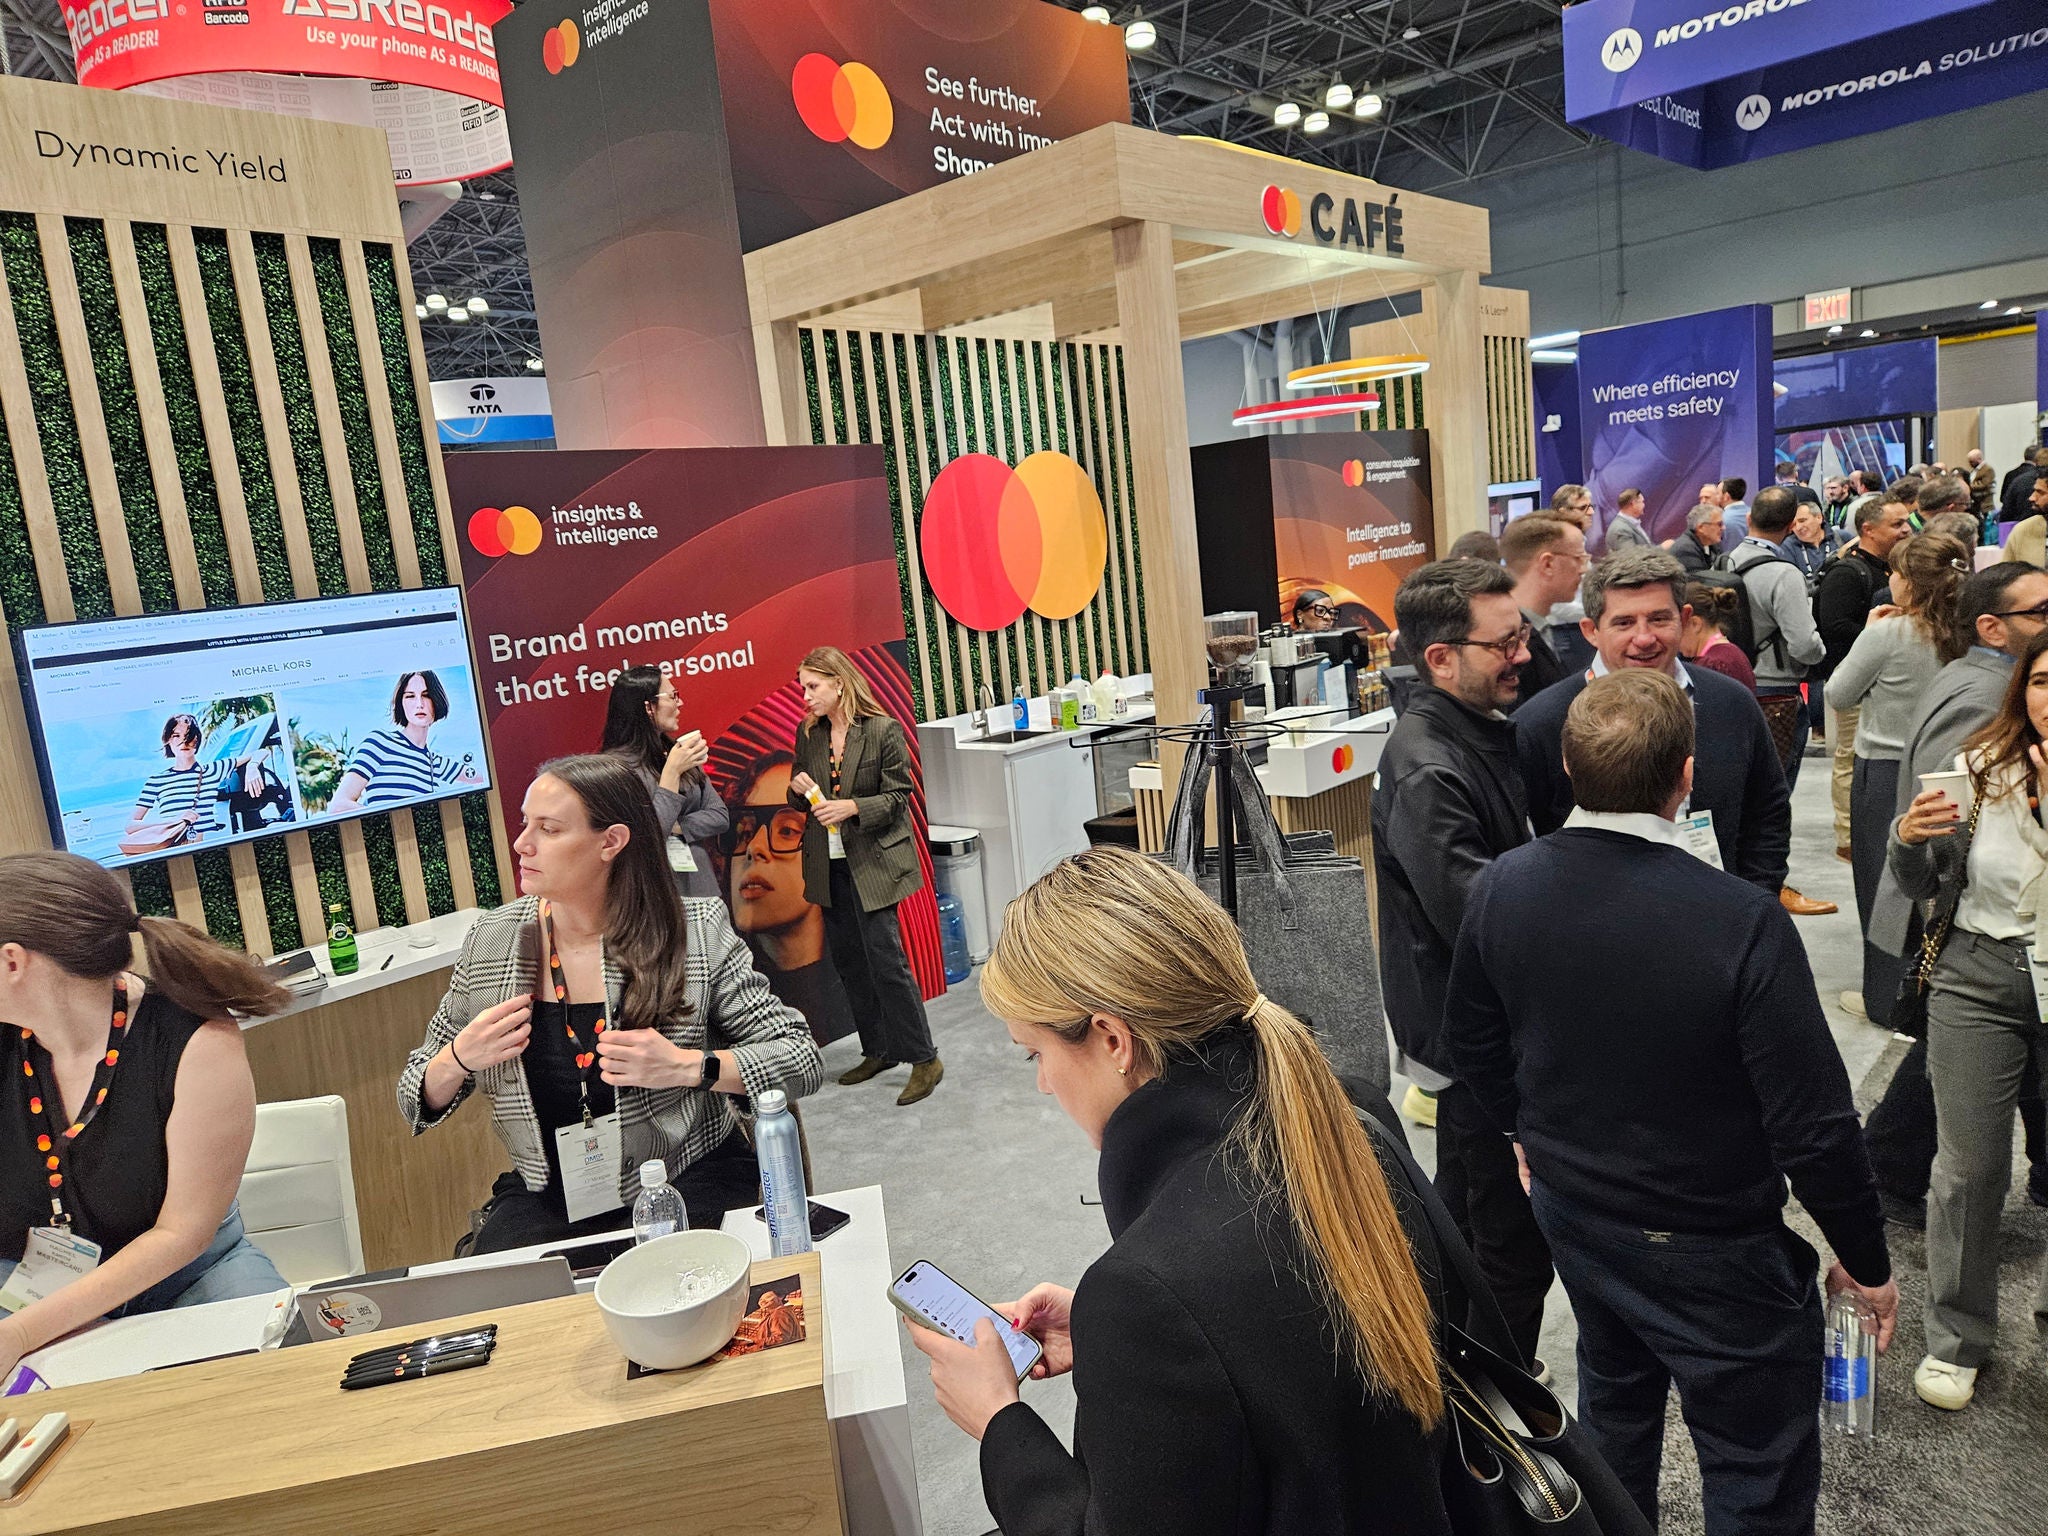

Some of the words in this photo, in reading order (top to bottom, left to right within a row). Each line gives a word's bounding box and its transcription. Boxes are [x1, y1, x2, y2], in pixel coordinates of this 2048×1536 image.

[204, 12, 249, 25] Barcode
[585, 0, 649, 48] intelligence
[94, 45, 104, 65] AS
[105, 46, 111, 60] a
[112, 29, 159, 56] READER!
[306, 26, 336, 44] Use
[340, 32, 378, 49] your
[382, 37, 427, 60] phone
[429, 47, 446, 65] AS
[449, 54, 457, 67] a
[371, 82, 399, 91] Barcode
[924, 66, 964, 100] See
[968, 77, 1042, 119] further.
[1780, 59, 1933, 112] MOTOROLA
[463, 117, 482, 131] RFID
[929, 107, 967, 138] Act
[969, 119, 1014, 149] with
[34, 129, 200, 174] Dynamic
[205, 149, 287, 183] Yield
[1310, 193, 1405, 253] CAFÉ
[1808, 293, 1850, 323] EXIT
[1592, 382, 1649, 404] Where
[1652, 368, 1740, 395] efficiency
[468, 404, 502, 415] TATA
[1609, 404, 1664, 425] meets
[1667, 395, 1724, 418] safety
[1366, 460, 1392, 470] consumer
[1392, 456, 1420, 469] acquisition
[1366, 471, 1371, 482] &
[1372, 469, 1407, 483] engagement
[551, 504, 626, 526] insights
[628, 501, 644, 520] &
[554, 524, 659, 547] intelligence
[1346, 523, 1399, 543] Intelligence
[1400, 520, 1412, 535] to
[1348, 550, 1378, 570] power
[1378, 540, 1426, 561] innovation
[489, 623, 588, 663] Brand
[596, 610, 729, 649] moments
[232, 664, 280, 677] MICHAEL
[283, 659, 312, 670] KORS
[495, 674, 570, 707] that
[649, 640, 756, 680] ersonal
[762, 1169, 777, 1238] smartwater
[36, 1250, 83, 1273] MASTERCARD
